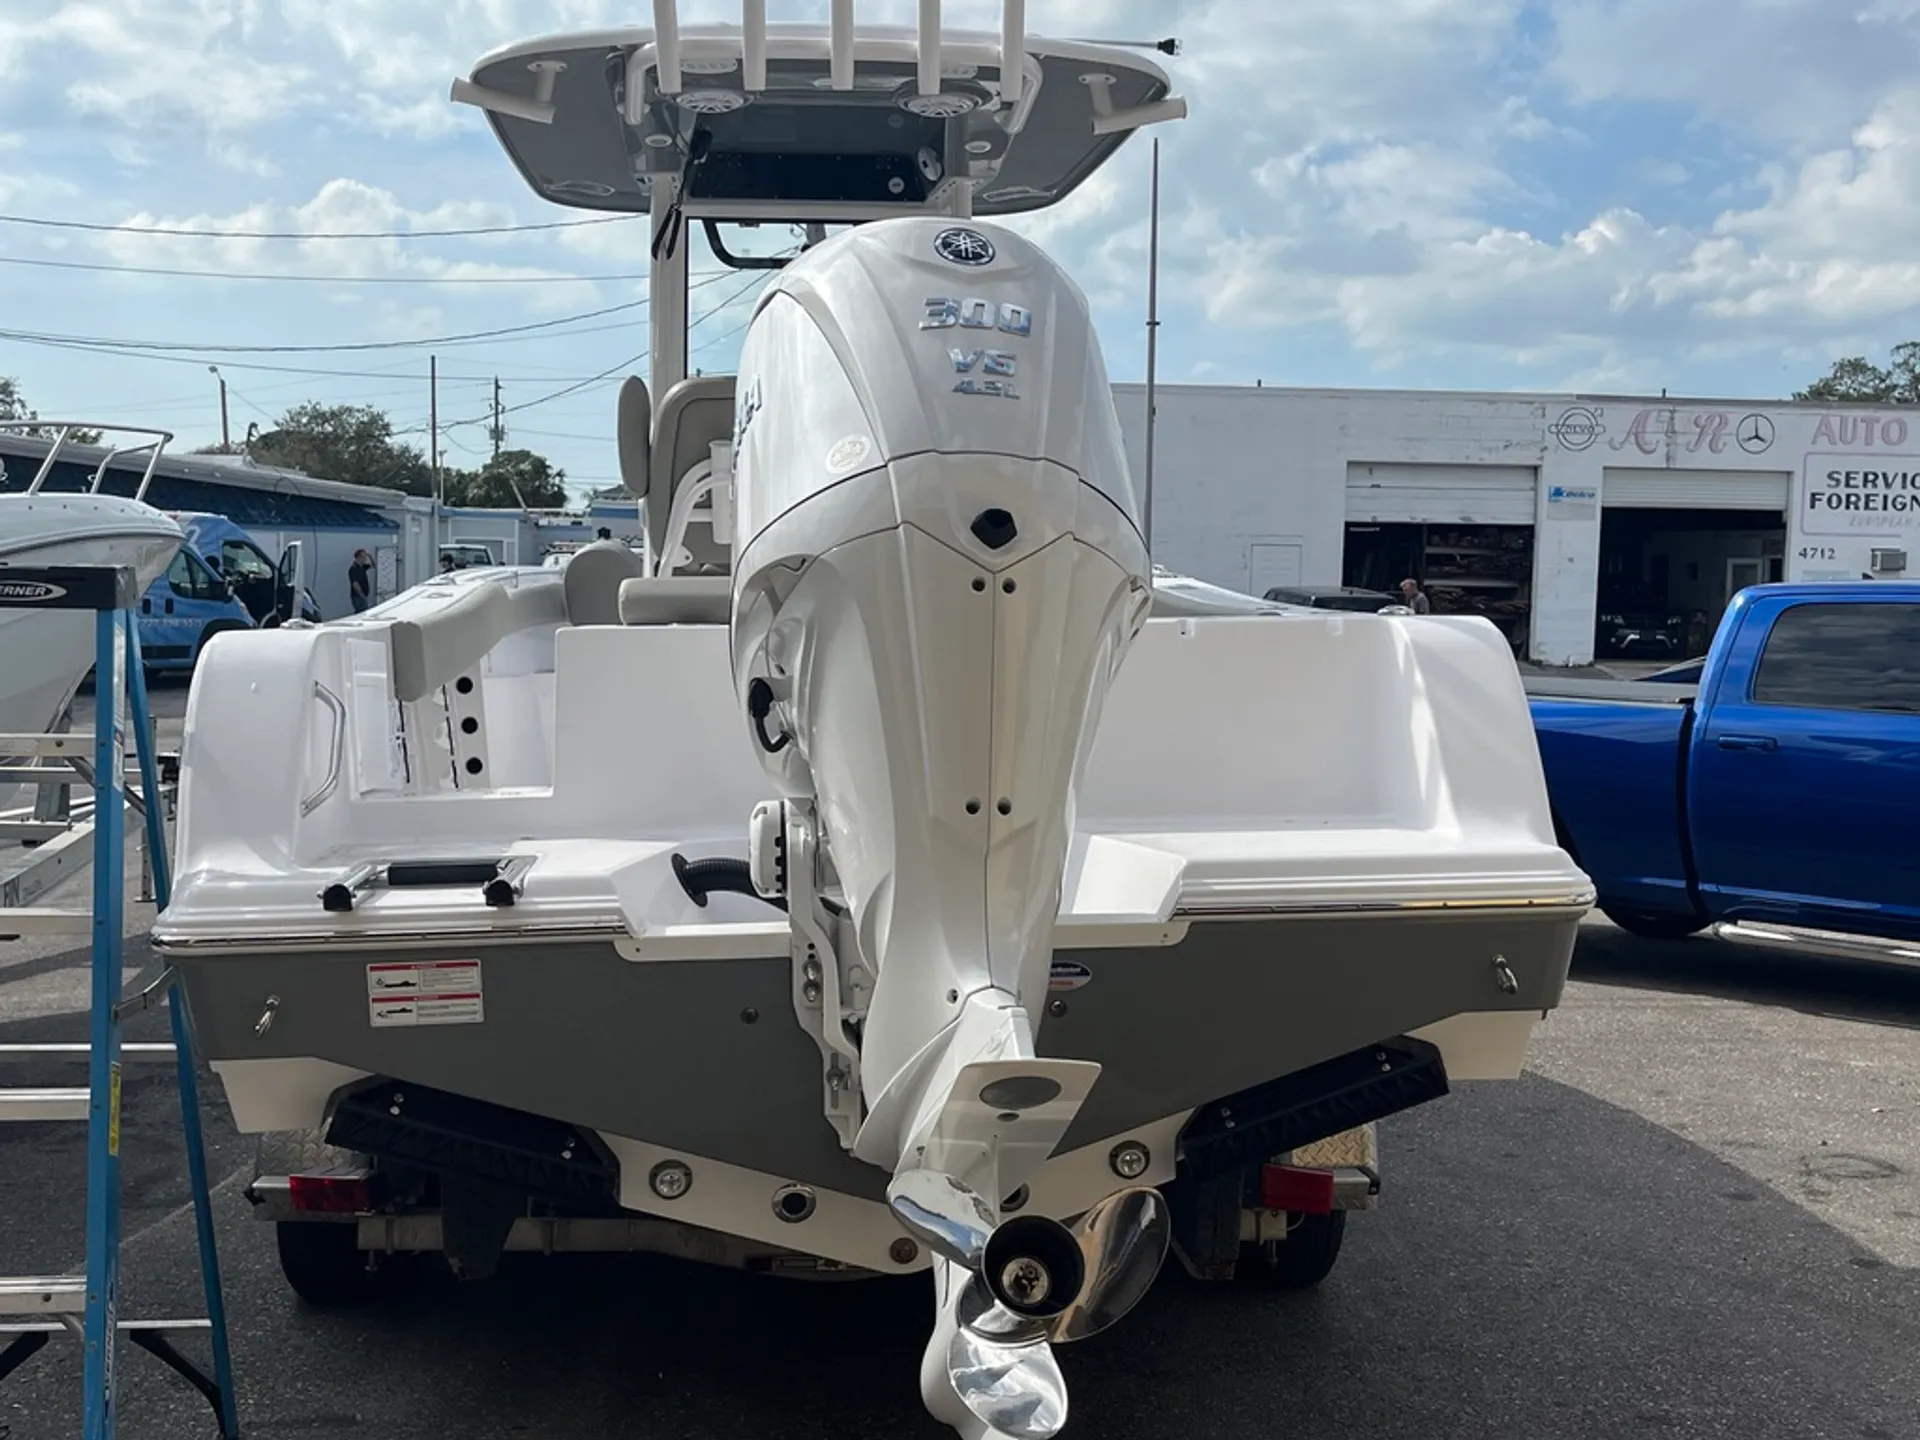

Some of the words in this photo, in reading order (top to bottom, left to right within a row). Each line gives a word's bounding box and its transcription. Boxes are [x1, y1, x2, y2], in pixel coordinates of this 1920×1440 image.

[919, 298, 1032, 337] 300
[946, 348, 1016, 377] V6
[1811, 414, 1908, 446] AUTO
[1798, 547, 1836, 560] 4712
